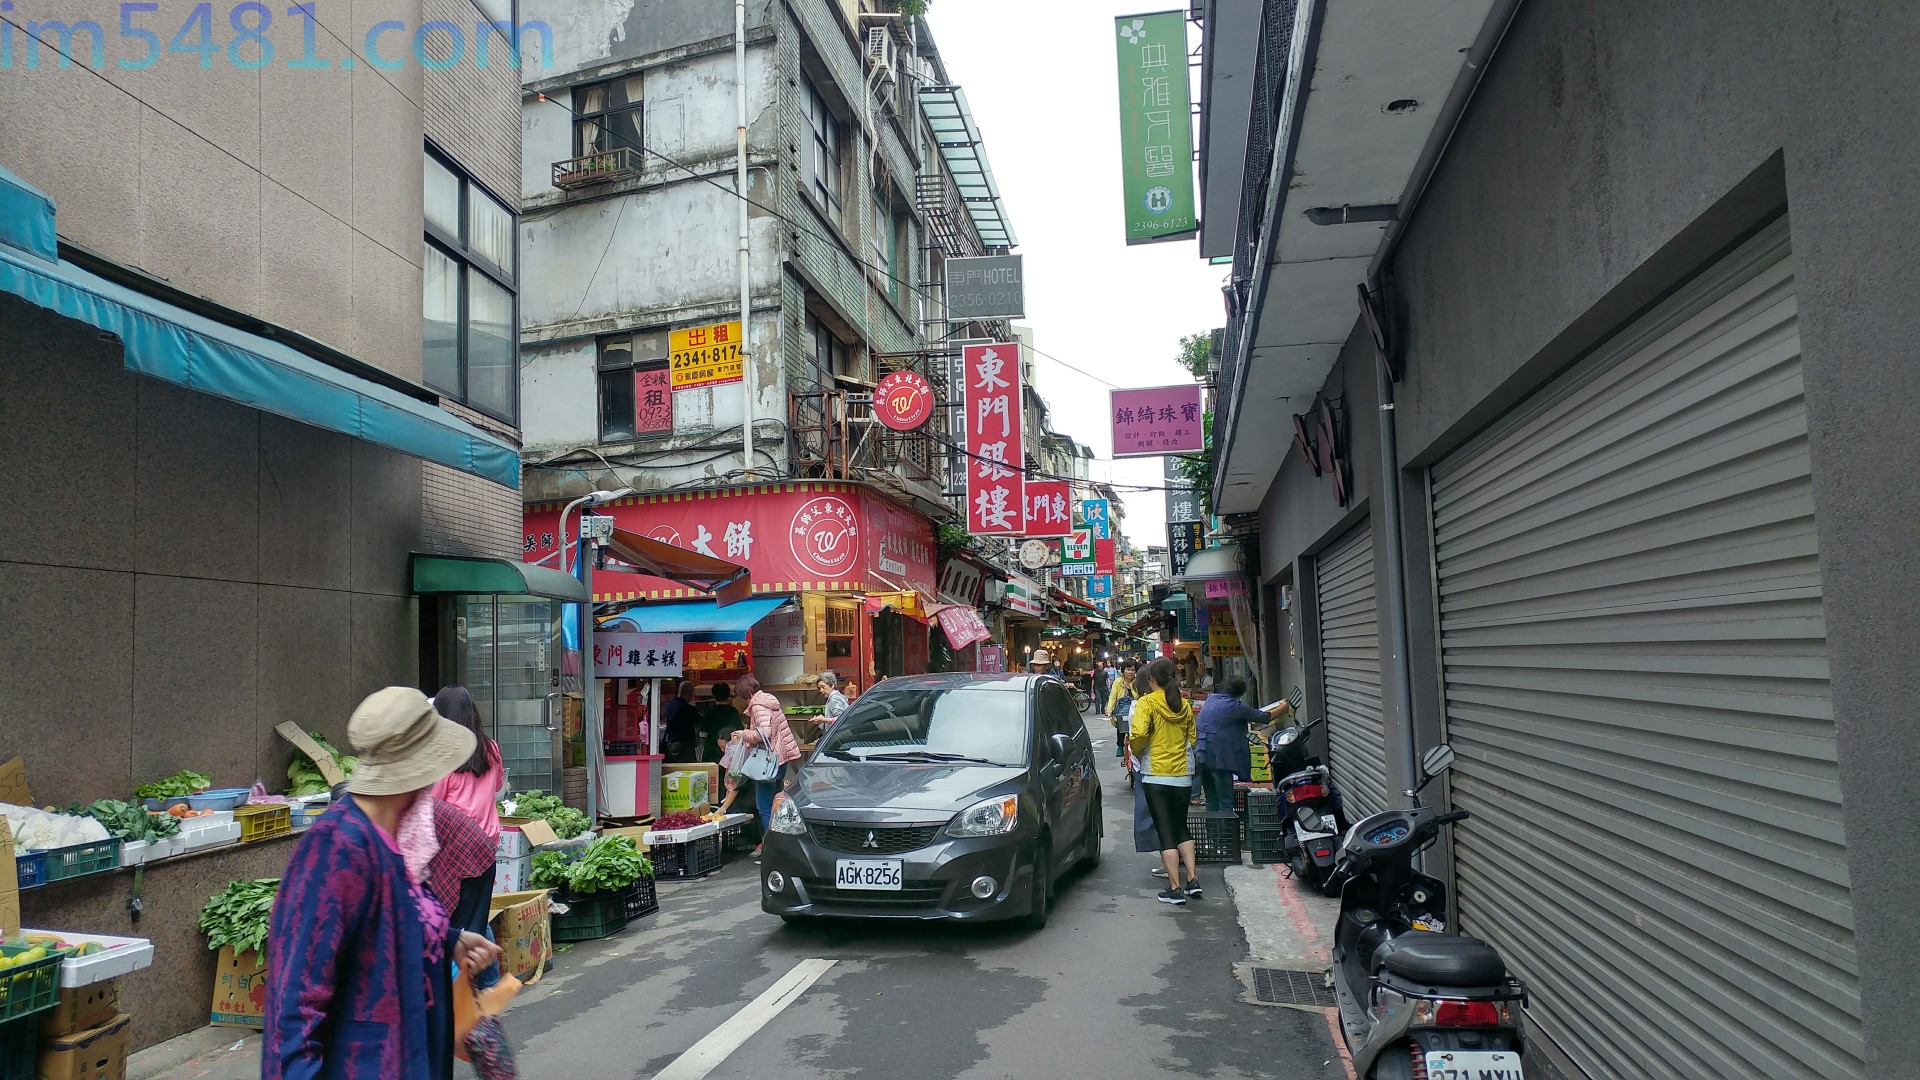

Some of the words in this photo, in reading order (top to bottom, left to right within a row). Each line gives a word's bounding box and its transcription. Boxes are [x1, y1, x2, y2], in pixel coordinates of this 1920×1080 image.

[1134, 217, 1188, 232] 2396-6123
[950, 291, 1022, 307] 2356-0210
[689, 325, 728, 347] 出租
[644, 390, 665, 407] 租
[640, 405, 670, 420] 0923
[1115, 402, 1198, 426] 錦綺珠寶
[973, 347, 1017, 531] 東門銀樓
[593, 644, 677, 667] 東門雞蛋糕
[838, 867, 900, 885] AGK-8256
